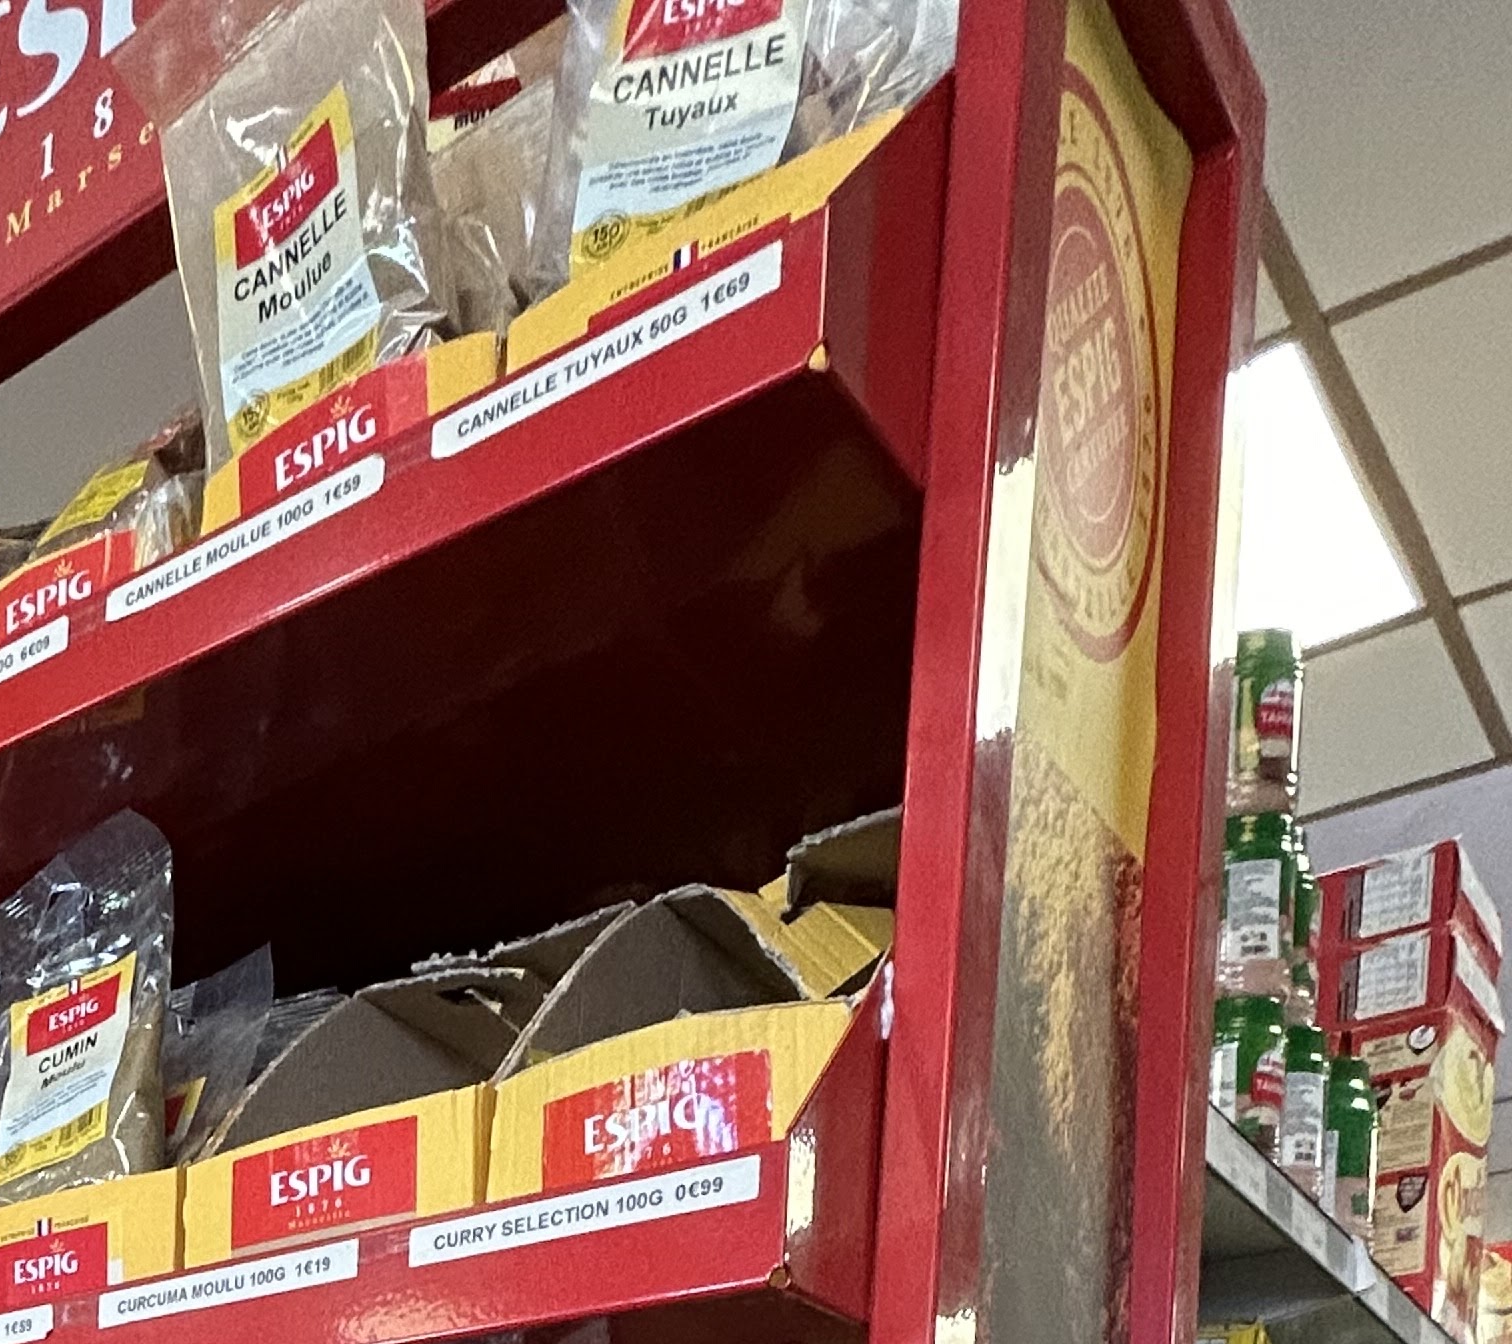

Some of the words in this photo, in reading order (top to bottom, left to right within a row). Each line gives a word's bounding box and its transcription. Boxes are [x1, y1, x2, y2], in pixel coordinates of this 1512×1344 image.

[613, 33, 787, 104] CANNELLE
[645, 92, 739, 130] Tuyaux
[234, 188, 348, 302] CANNELLE
[257, 252, 332, 324] Moulue
[456, 371, 558, 439] CANNELLE
[563, 330, 644, 384] TUYAUX
[649, 306, 688, 340] 50G
[700, 272, 751, 311] 1€69
[274, 404, 376, 492] ESPIG
[125, 557, 202, 607] CANNELLE
[205, 522, 272, 571] MOULUE
[277, 500, 314, 532] 100G
[323, 474, 363, 508] 1€59
[6, 571, 92, 635] ESPIG
[49, 996, 99, 1033] ESPIG
[39, 1034, 99, 1076] CUMIN
[271, 1154, 372, 1207] ESPIG
[434, 1223, 496, 1251] CURRY
[500, 1200, 609, 1238] SELECTION
[615, 1186, 664, 1213] 100G
[675, 1175, 724, 1202] 0€99
[15, 1250, 79, 1285] ESPIG
[116, 1282, 188, 1316] CURCUMA
[191, 1274, 246, 1301] MOULU
[249, 1265, 286, 1287] 100G
[294, 1255, 331, 1280] 1€19
